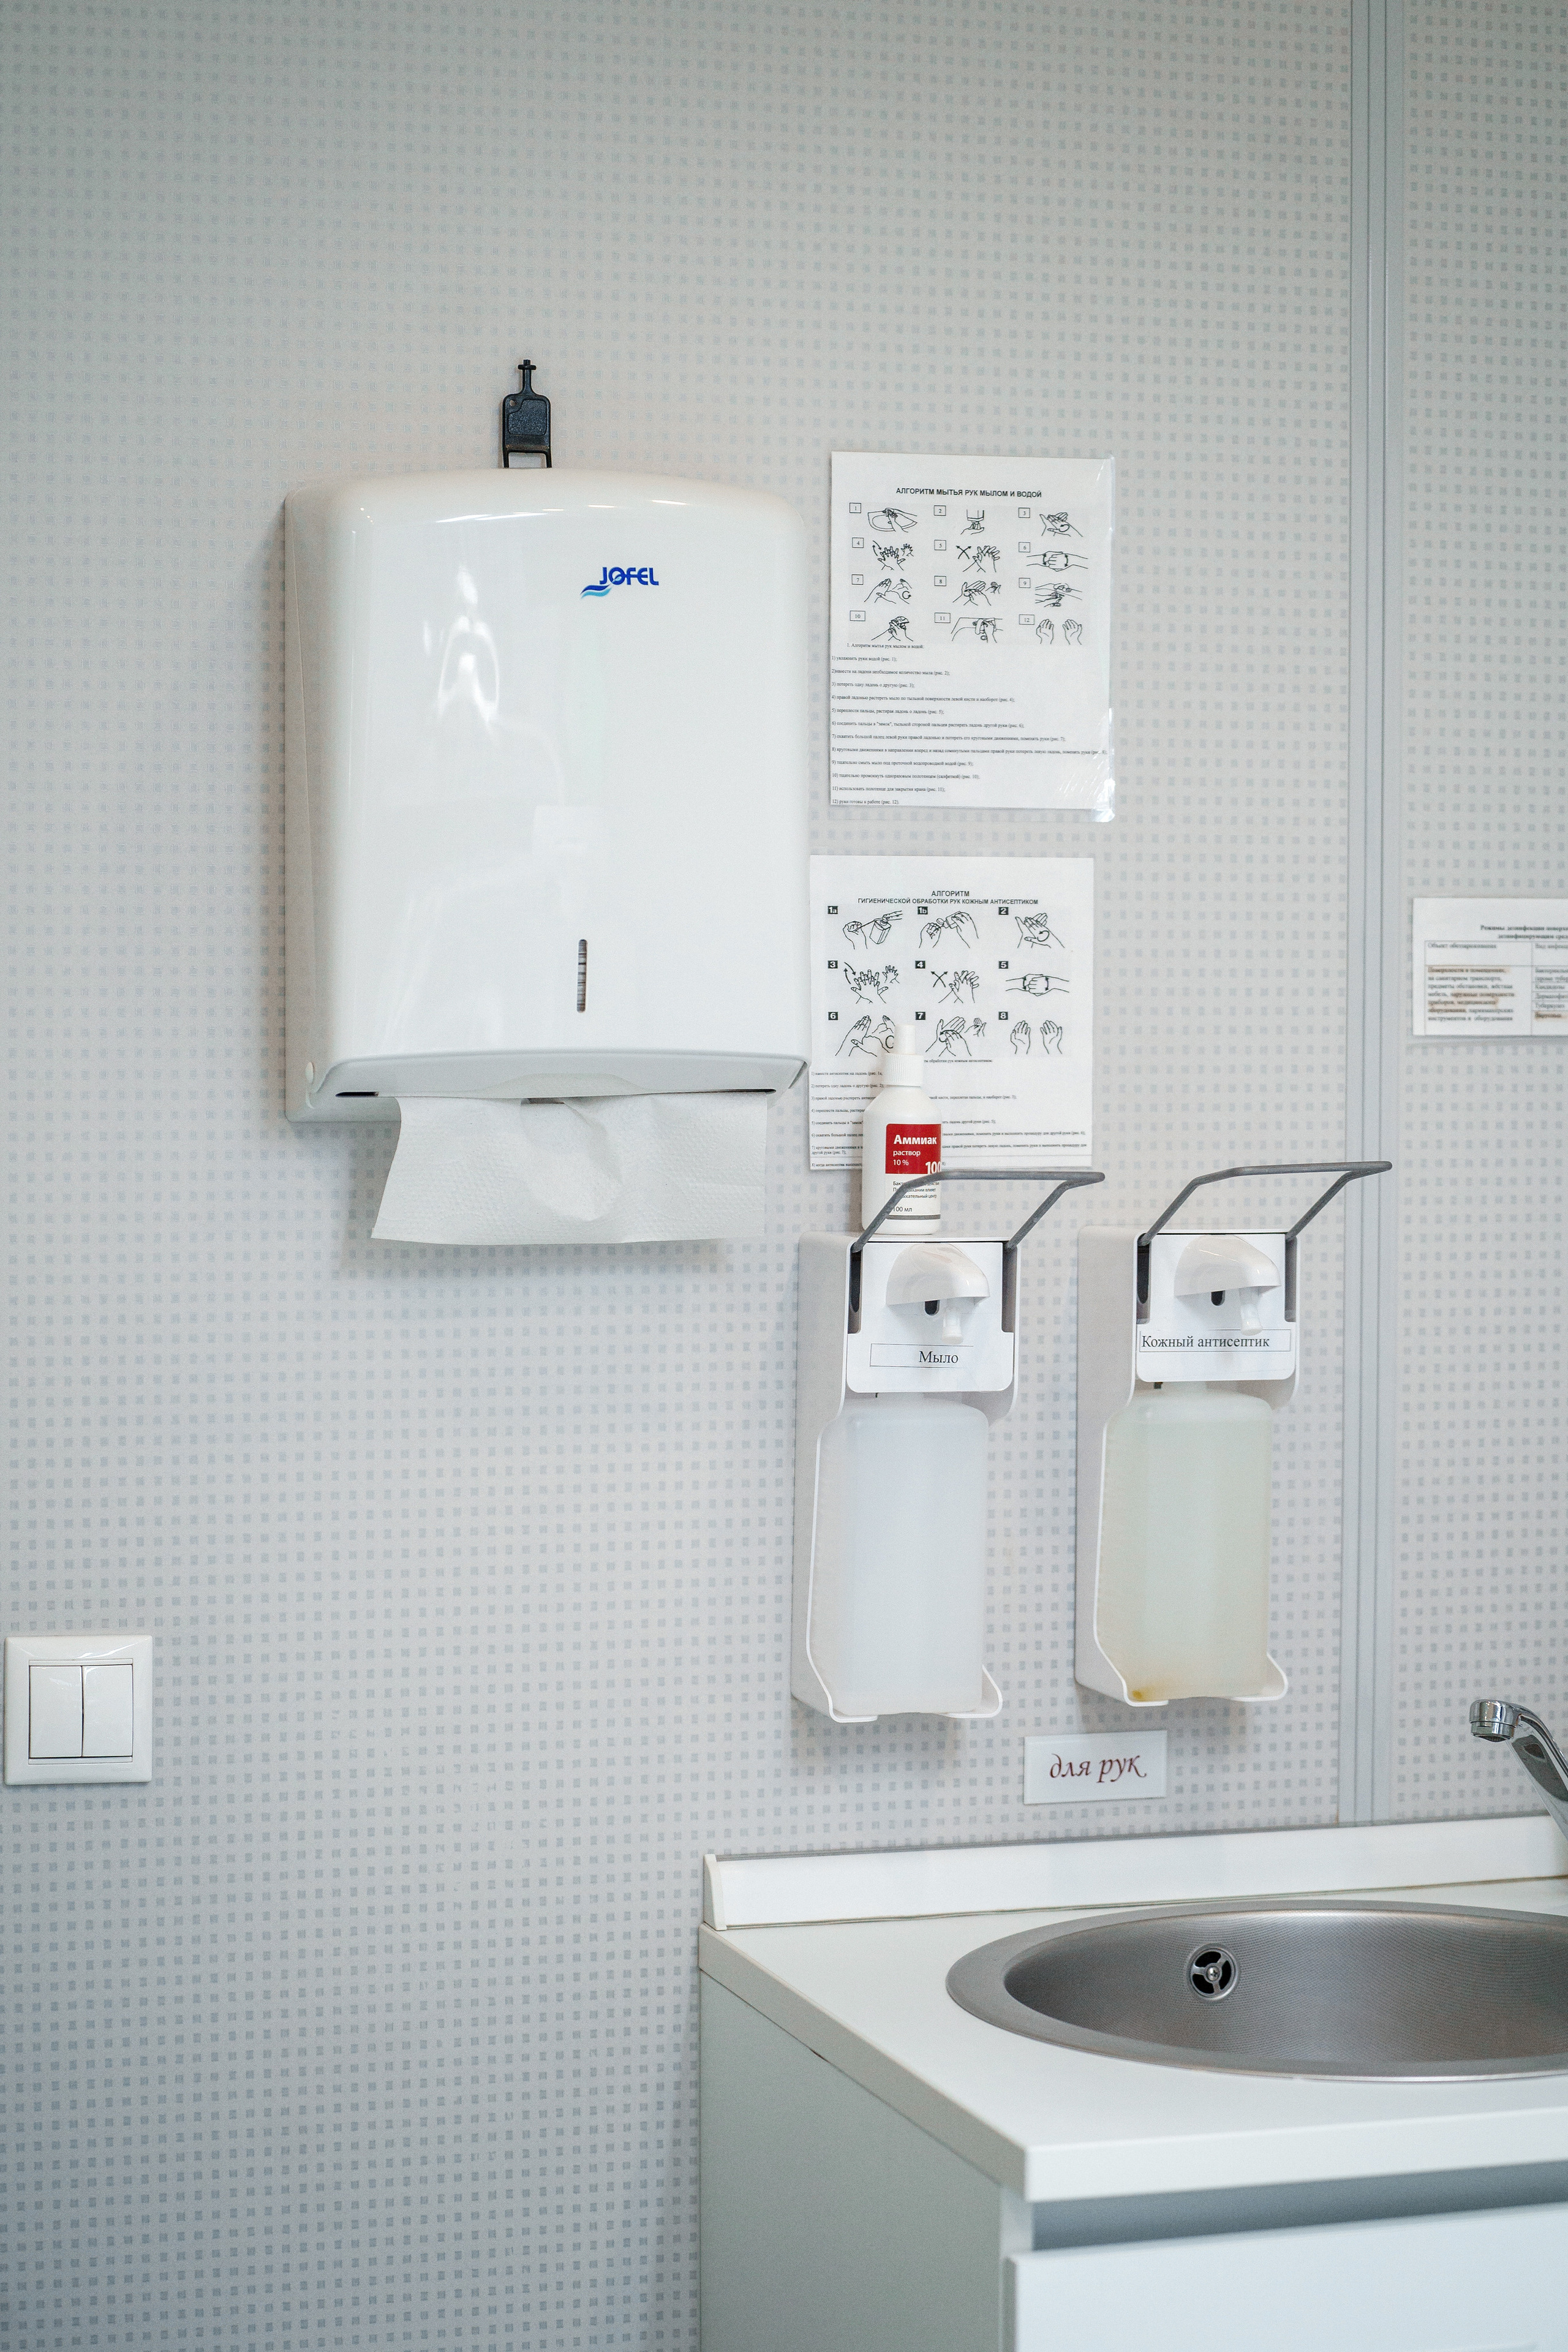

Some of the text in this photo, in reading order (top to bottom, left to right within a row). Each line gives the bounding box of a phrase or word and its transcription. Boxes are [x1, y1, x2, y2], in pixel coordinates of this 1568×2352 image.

[599, 567, 659, 586] JOFEL
[893, 1135, 937, 1145] Аммиак
[925, 1161, 941, 1175] 100
[1142, 1336, 1270, 1348] Кожный антисептик
[919, 1351, 959, 1363] Мыло
[1049, 1753, 1147, 1784] для рук
